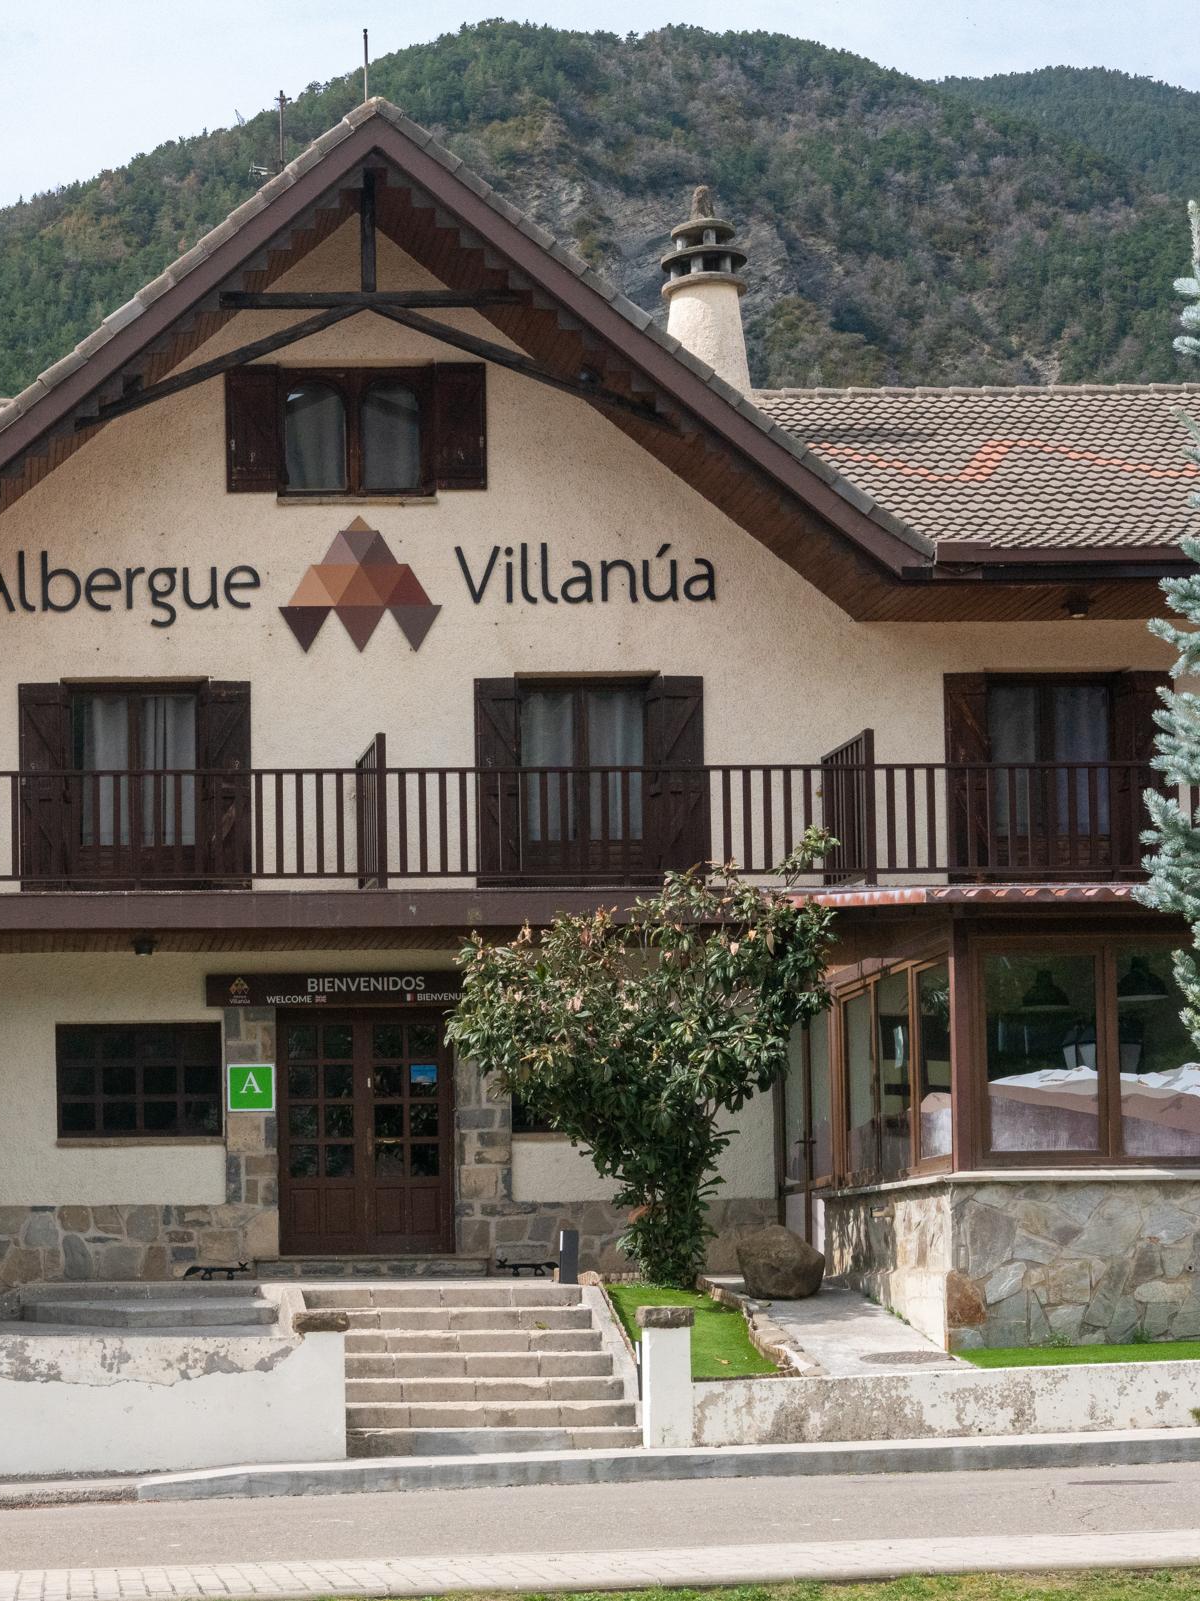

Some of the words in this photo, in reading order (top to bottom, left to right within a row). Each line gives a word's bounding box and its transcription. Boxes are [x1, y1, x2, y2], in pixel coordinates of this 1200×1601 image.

[455, 542, 718, 604] Villanúa
[307, 976, 425, 992] BIENVENIDOS
[266, 995, 312, 1004] WELCOME
[240, 1072, 263, 1094] A
